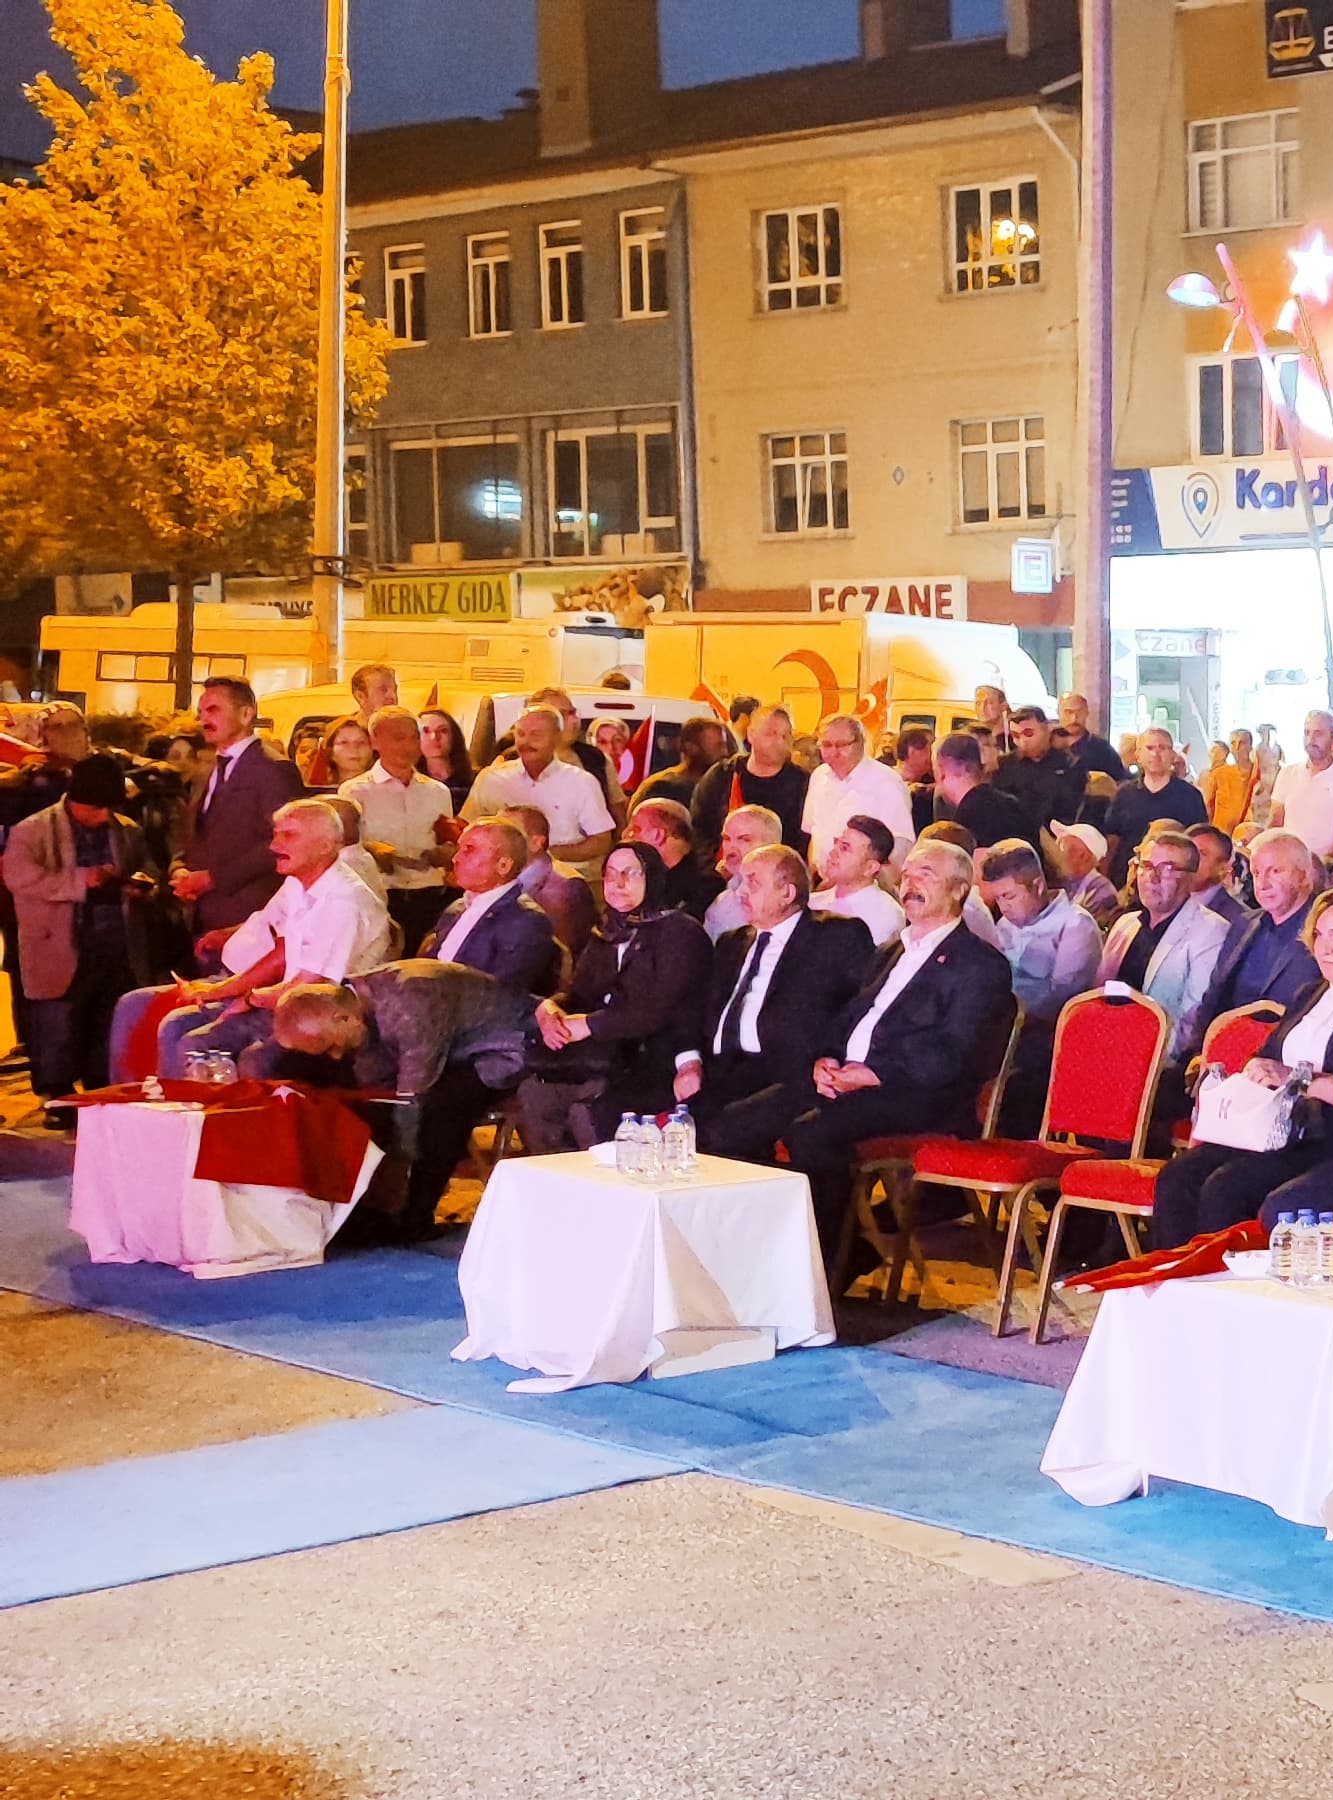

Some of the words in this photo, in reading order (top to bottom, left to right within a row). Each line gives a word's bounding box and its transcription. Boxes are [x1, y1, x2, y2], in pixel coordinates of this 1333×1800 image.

[372, 582, 449, 615] MERKEZ
[457, 581, 507, 614] GIDA
[818, 584, 953, 619] ECZANE
